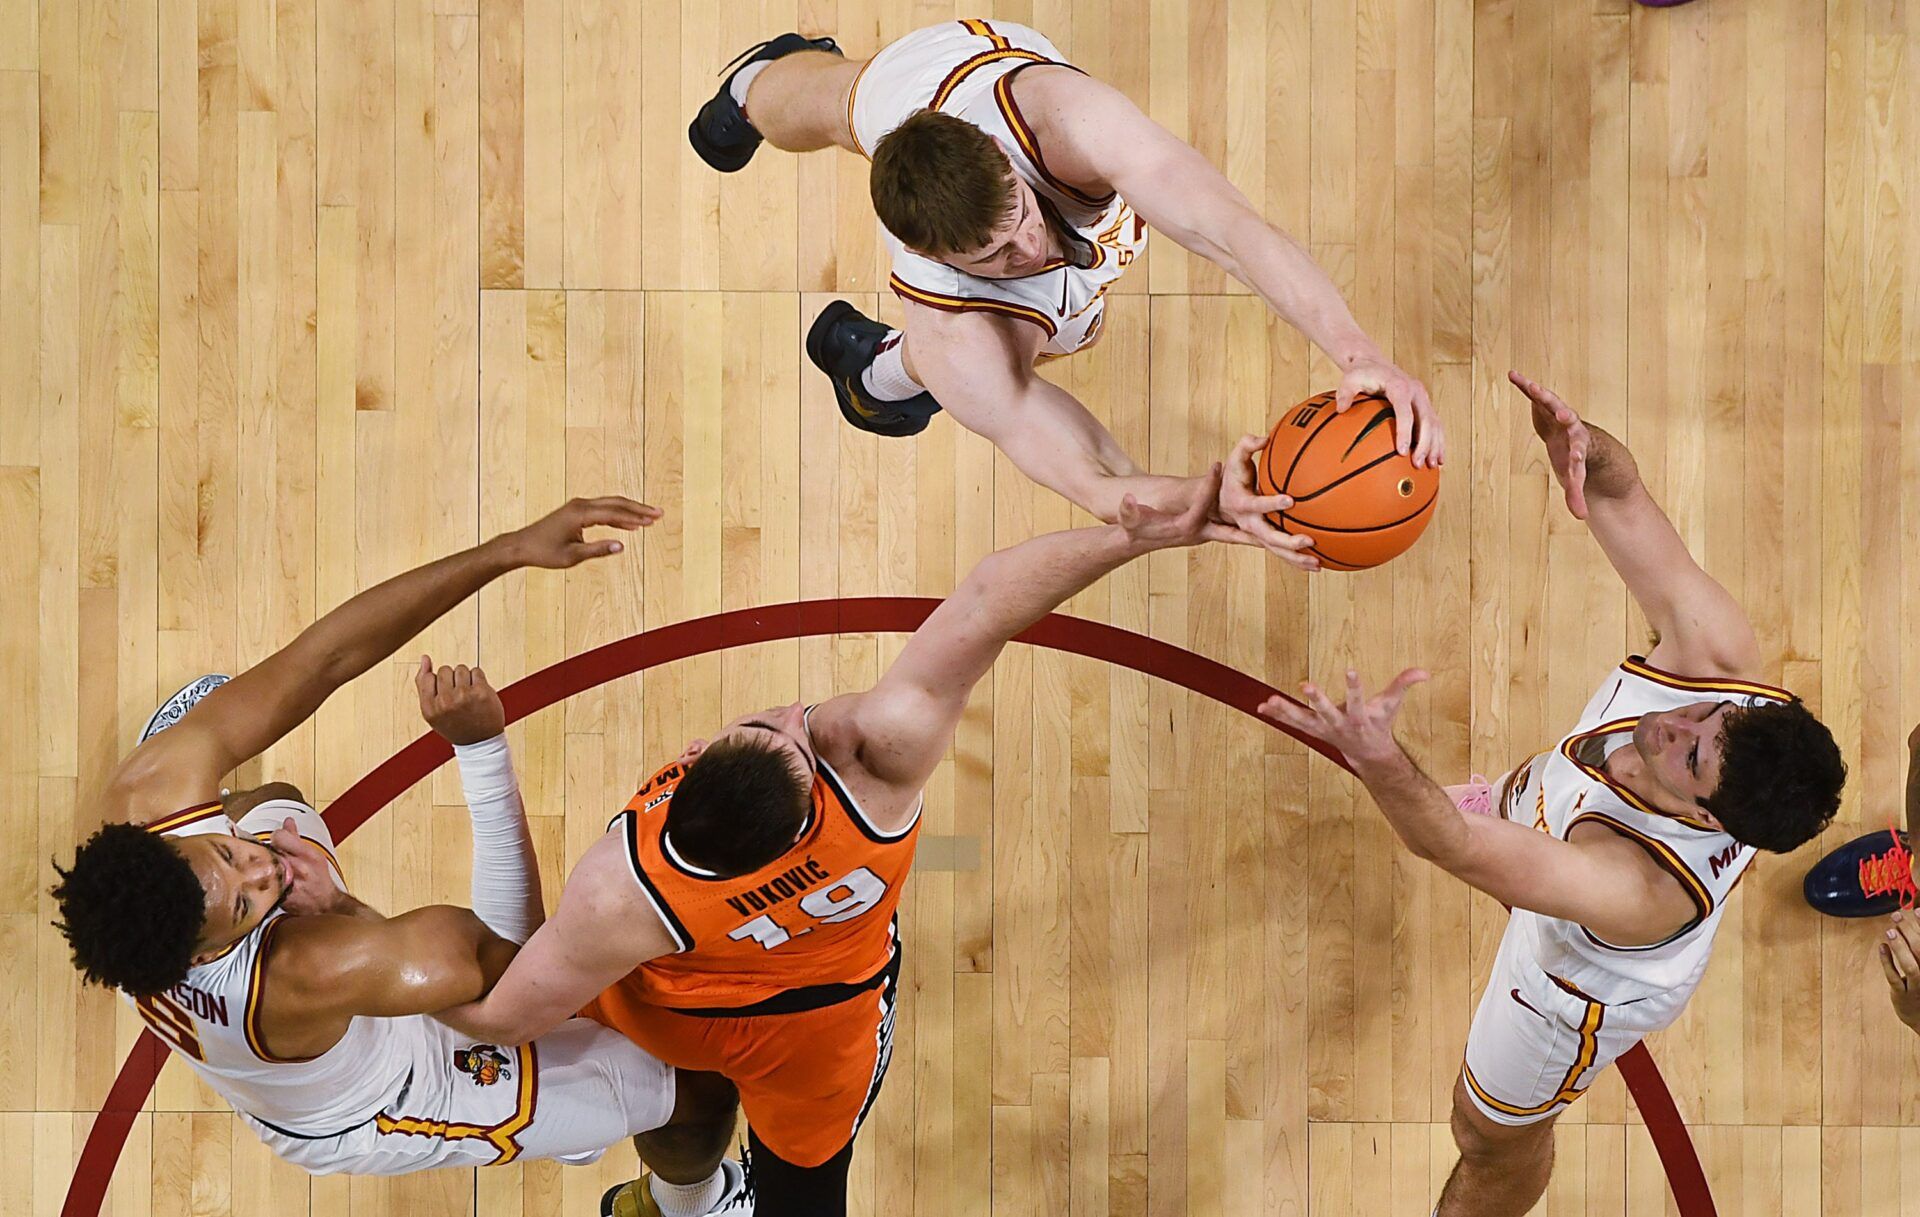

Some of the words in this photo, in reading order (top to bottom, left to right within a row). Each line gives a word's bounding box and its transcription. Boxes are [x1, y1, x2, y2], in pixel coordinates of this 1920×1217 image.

[1290, 394, 1337, 428] ELI
[725, 855, 829, 917] VUKOVIĆ
[727, 856, 888, 951] 19
